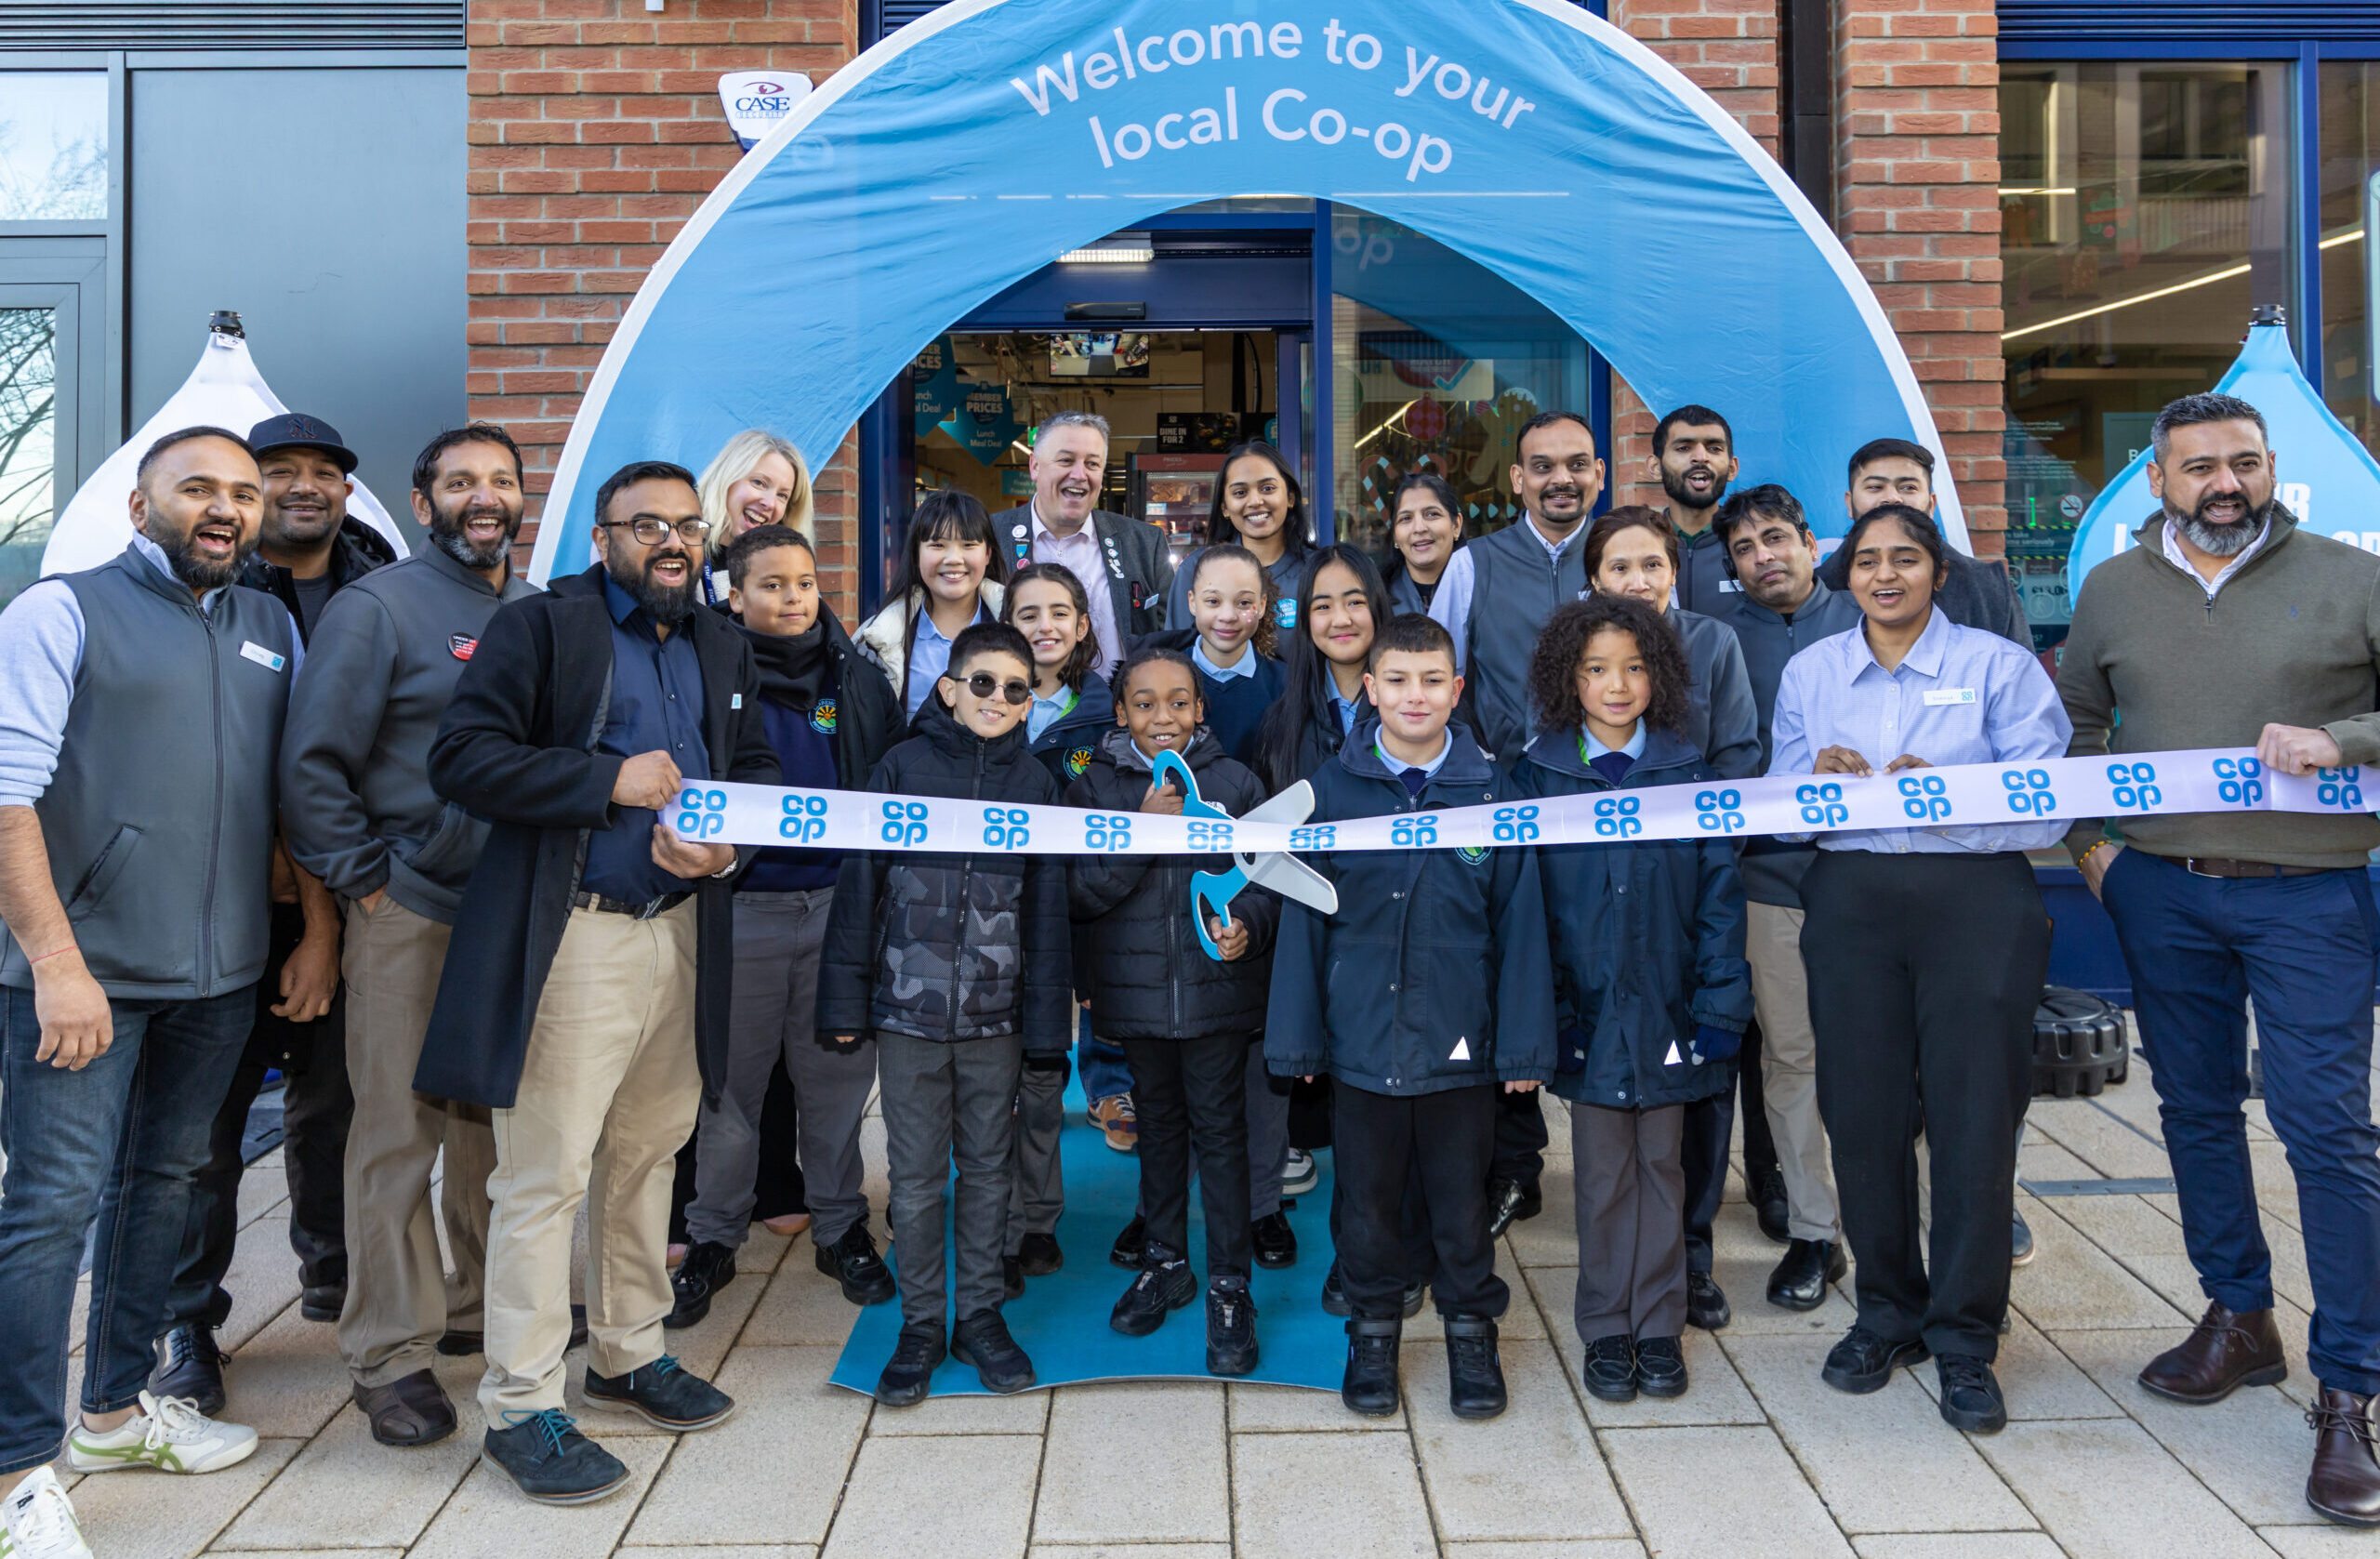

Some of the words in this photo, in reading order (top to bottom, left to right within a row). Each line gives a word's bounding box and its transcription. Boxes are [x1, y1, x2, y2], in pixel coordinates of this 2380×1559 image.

[1010, 21, 1302, 116] Welcome
[1324, 19, 1382, 70] to
[1395, 46, 1536, 129] your
[735, 97, 790, 112] CASE
[1090, 87, 1237, 168] local
[1263, 88, 1452, 182] Co-op
[922, 403, 941, 413] Deal
[966, 402, 1003, 414] PRICES
[970, 439, 986, 447] Meal
[987, 439, 1002, 447] Deal
